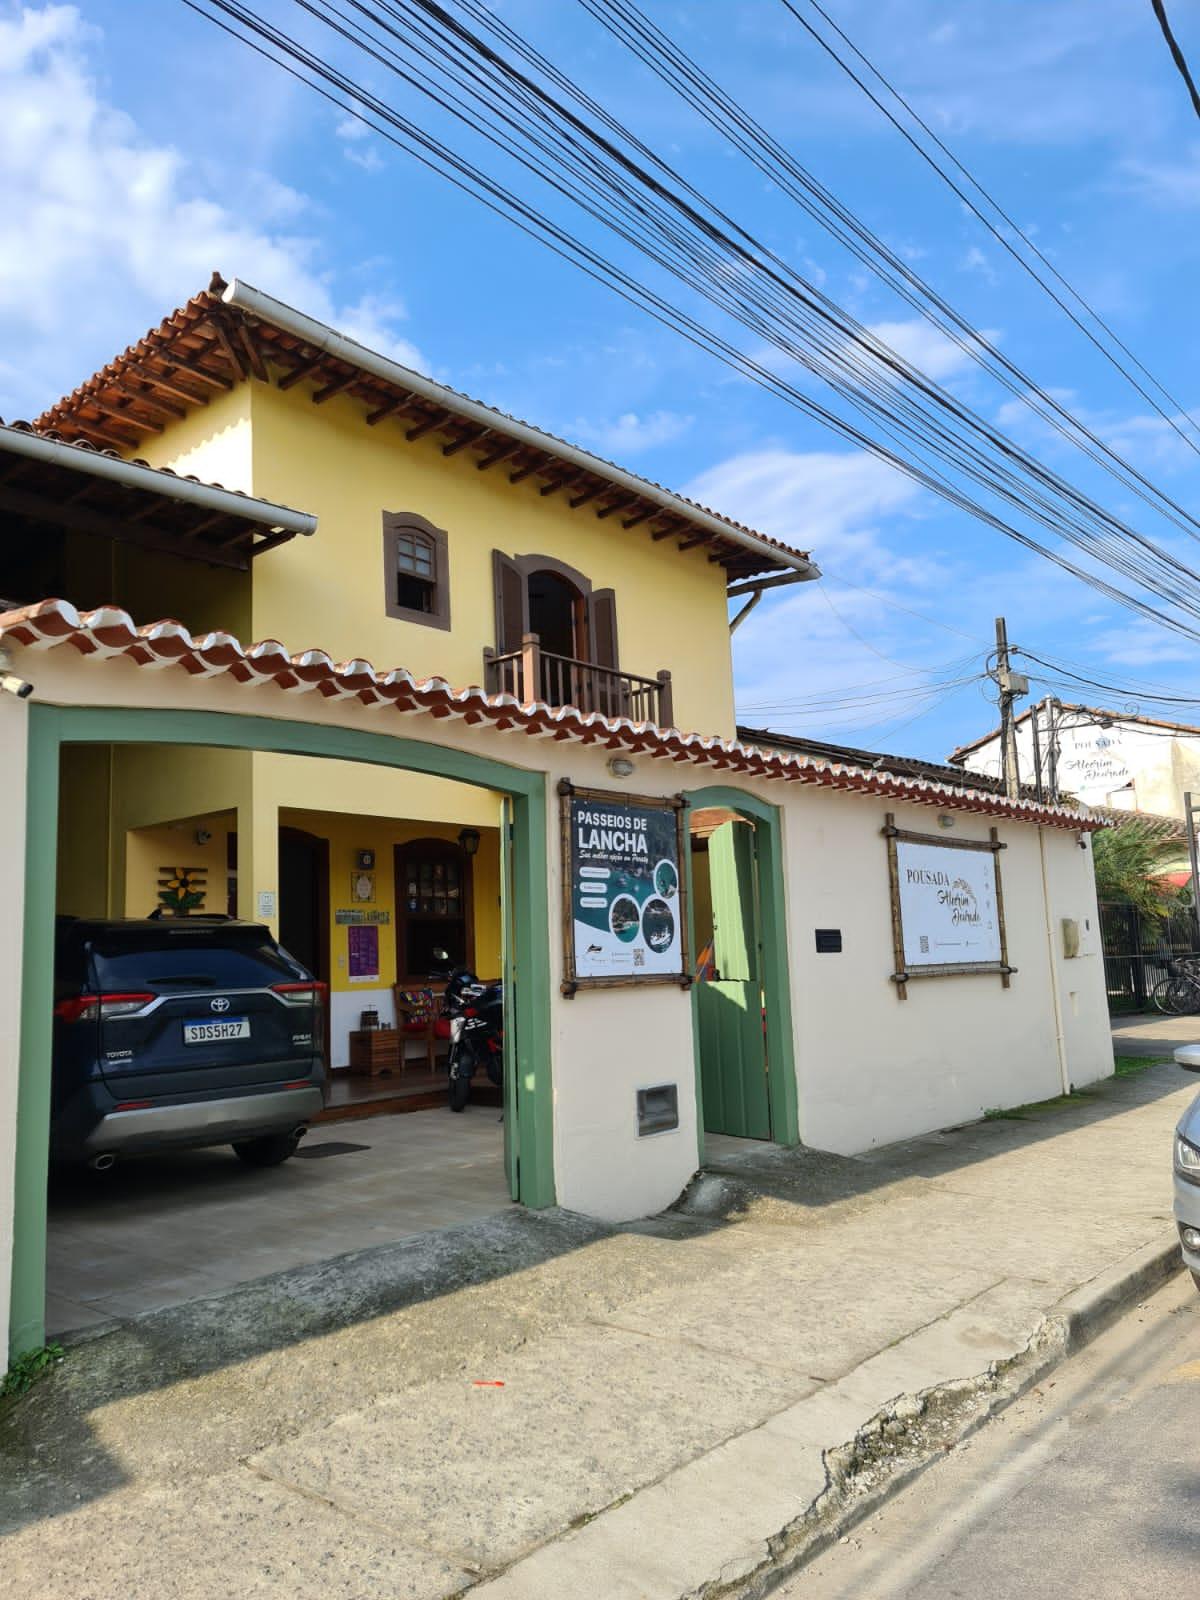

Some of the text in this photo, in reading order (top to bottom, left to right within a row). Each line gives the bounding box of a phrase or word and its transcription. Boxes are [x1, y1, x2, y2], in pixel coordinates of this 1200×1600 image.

[1064, 759, 1112, 771] Alecrim
[577, 810, 648, 831] PASSEIOS DE
[578, 827, 649, 854] LANCHA
[907, 869, 949, 886] POUSADA
[937, 889, 969, 909] Alecrim
[951, 907, 981, 927] Dourado
[191, 1023, 242, 1040] SDS5H27
[106, 1050, 133, 1058] TOYOTA
